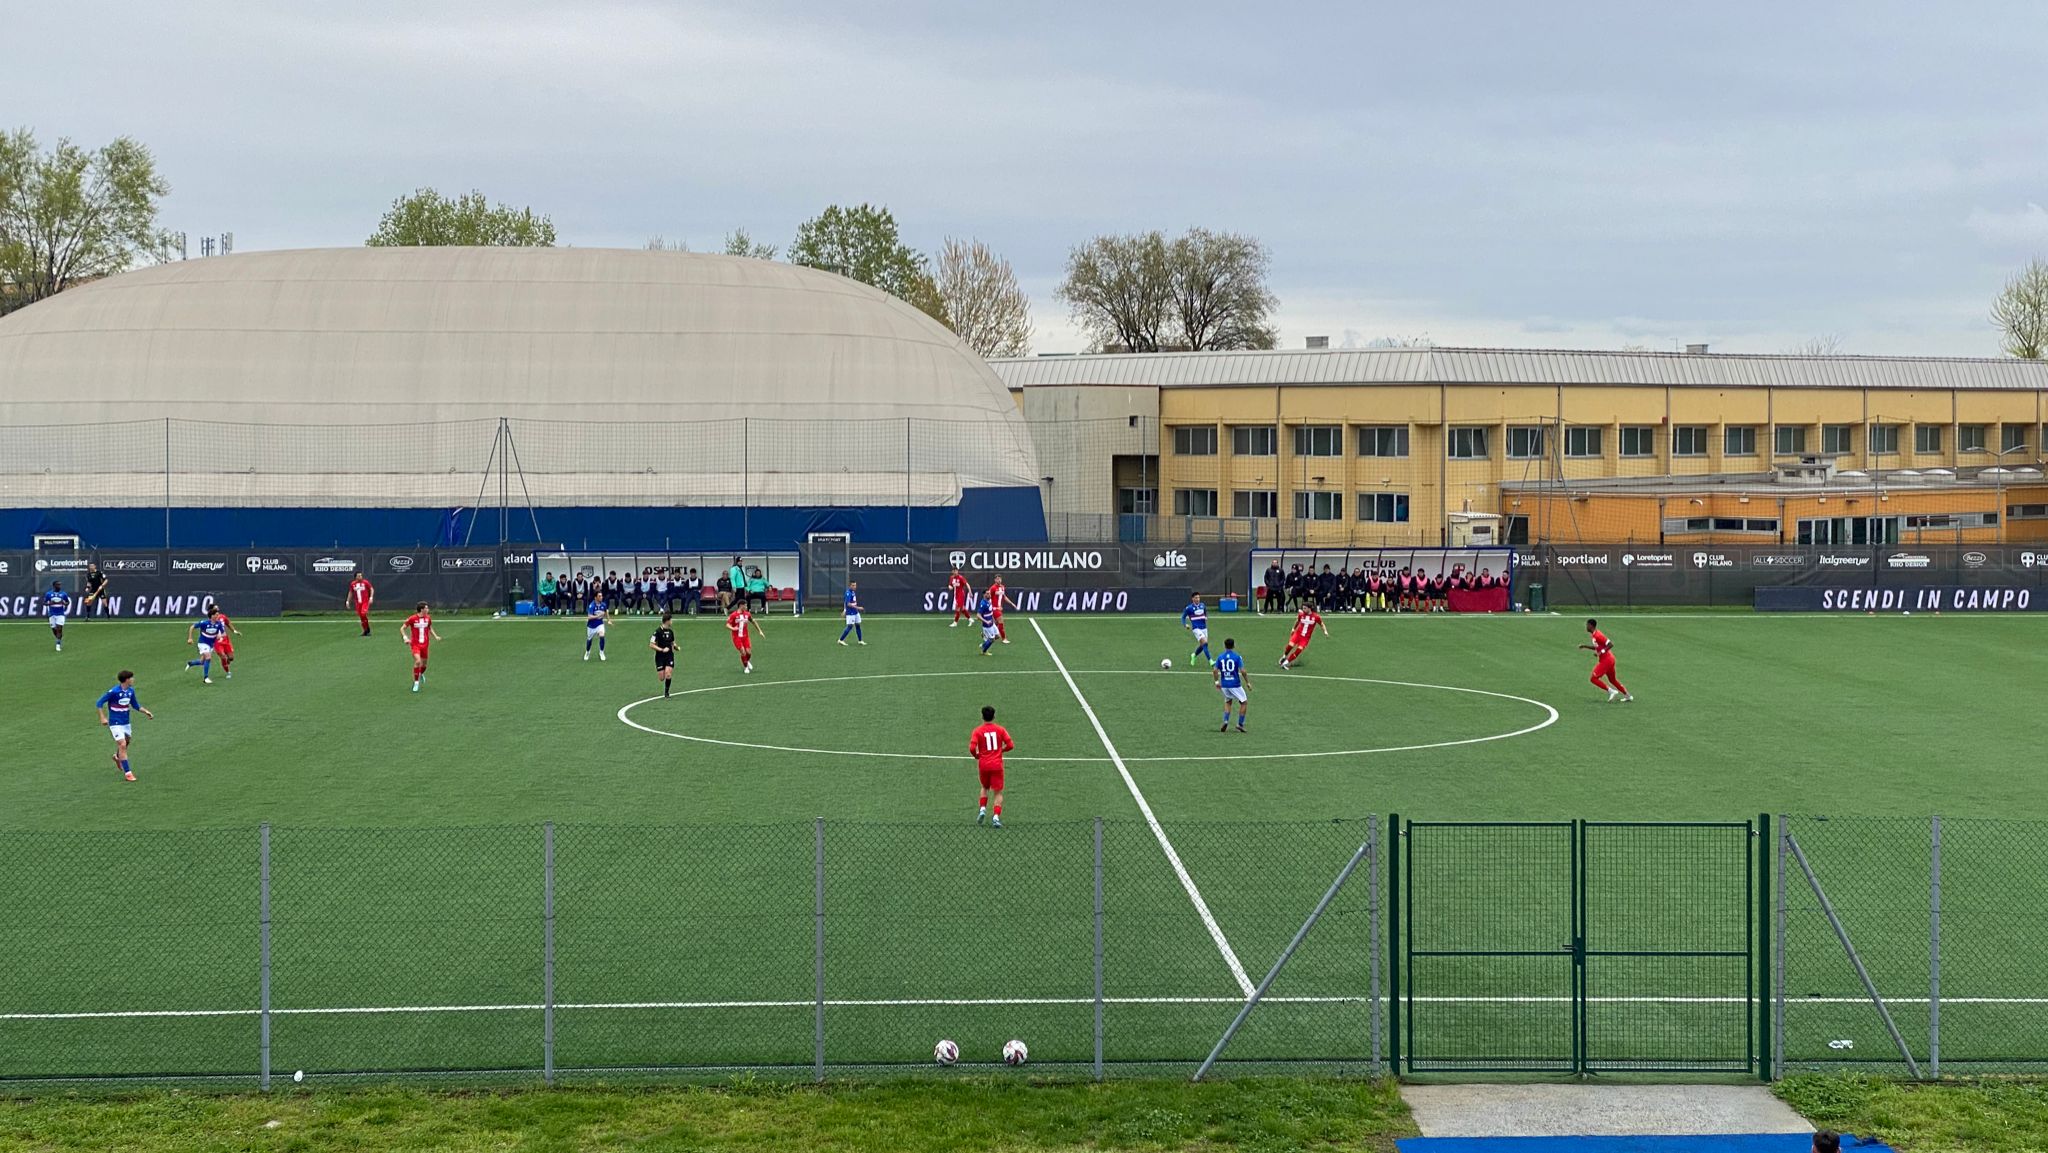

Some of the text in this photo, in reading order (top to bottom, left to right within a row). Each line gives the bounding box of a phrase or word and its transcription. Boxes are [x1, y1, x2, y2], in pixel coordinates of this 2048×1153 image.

[50, 560, 88, 568] Loretoprint
[852, 554, 909, 567] sportland
[970, 552, 1102, 569] CLUB MILANO
[1363, 560, 1396, 568] CLUB
[1557, 554, 1608, 566] sportland
[1637, 554, 1673, 562] Loretoprint
[1819, 555, 1862, 566] Italgreen
[172, 560, 215, 571] Italgreen
[134, 595, 215, 616] CAMPO
[1017, 592, 1041, 611] IN
[1053, 592, 1129, 611] CAMPO
[1822, 590, 2030, 609] SCENDI IN CAMPO
[1220, 658, 1235, 672] 10
[983, 731, 998, 751] 11
